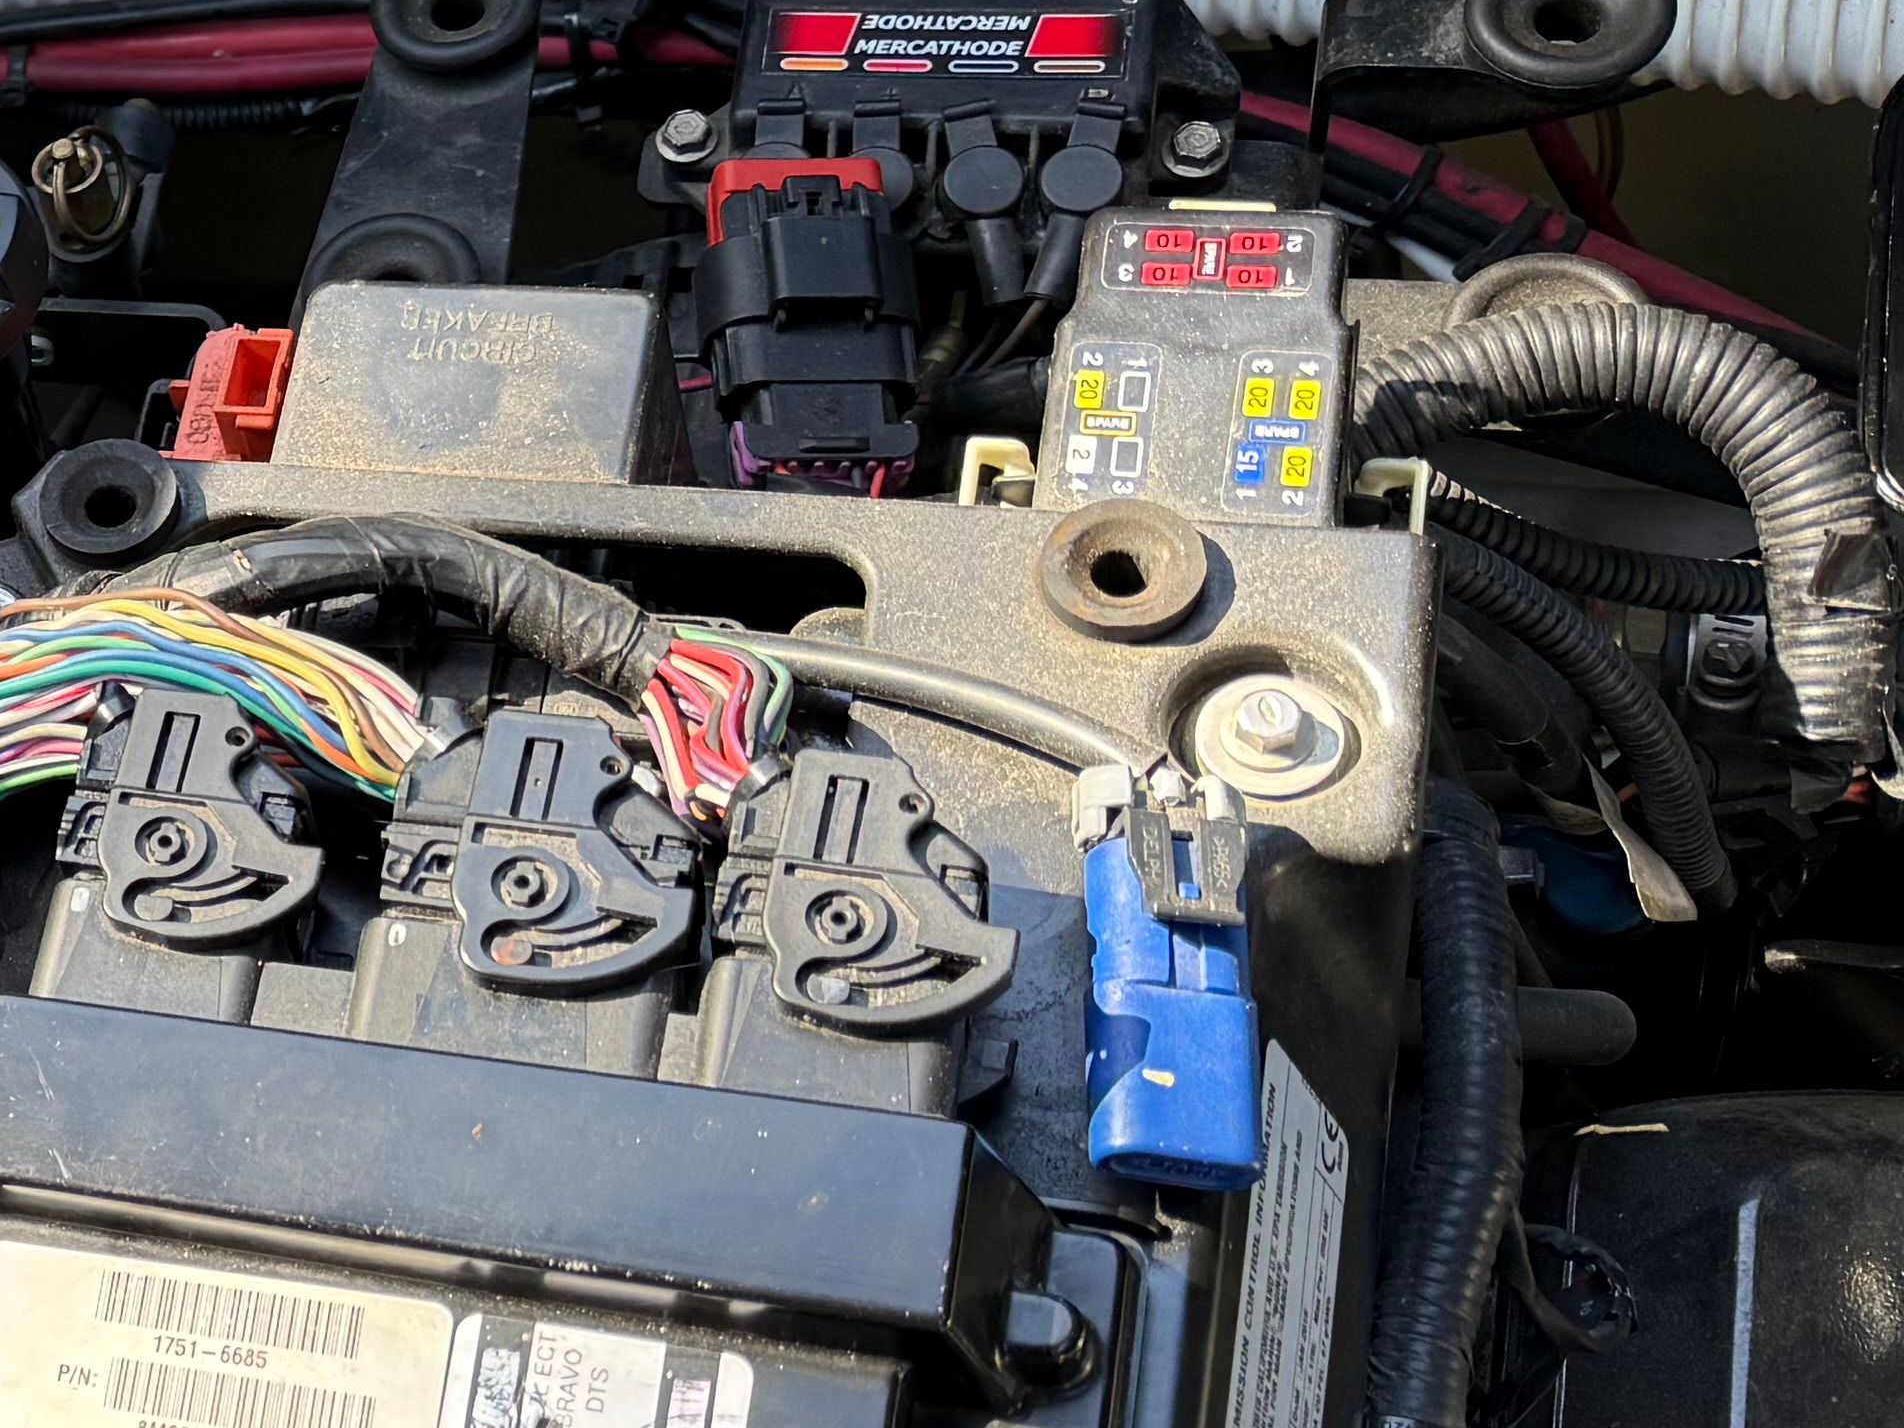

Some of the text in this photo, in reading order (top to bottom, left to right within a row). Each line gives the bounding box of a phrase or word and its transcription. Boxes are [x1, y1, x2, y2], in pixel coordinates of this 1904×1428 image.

[861, 15, 1031, 31] MERCATHODE
[854, 39, 1024, 56] MERCATHODE
[1157, 233, 1181, 248] 10
[1242, 236, 1267, 251] 10
[1152, 267, 1176, 281] 10
[1238, 269, 1261, 283] 10
[401, 300, 554, 333] BREAKER
[408, 337, 537, 364] CIRCUIT
[1082, 351, 1104, 367] 2
[1251, 358, 1274, 374] 3
[1298, 360, 1320, 377] 4
[1079, 379, 1099, 400] 20
[1248, 387, 1268, 408] 20
[1294, 389, 1315, 411] 20
[1072, 449, 1091, 460] 2
[1235, 450, 1260, 474] 15
[1286, 455, 1307, 477] 20
[1111, 480, 1135, 495] 3
[1235, 488, 1257, 500] 1
[1282, 490, 1304, 506] 2
[1143, 825, 1160, 883] DELPH
[1243, 1228, 1262, 1332] CONTROL
[153, 1334, 269, 1369] 1751-6685
[56, 1363, 101, 1389] P/N:
[585, 1366, 610, 1414] DTS
